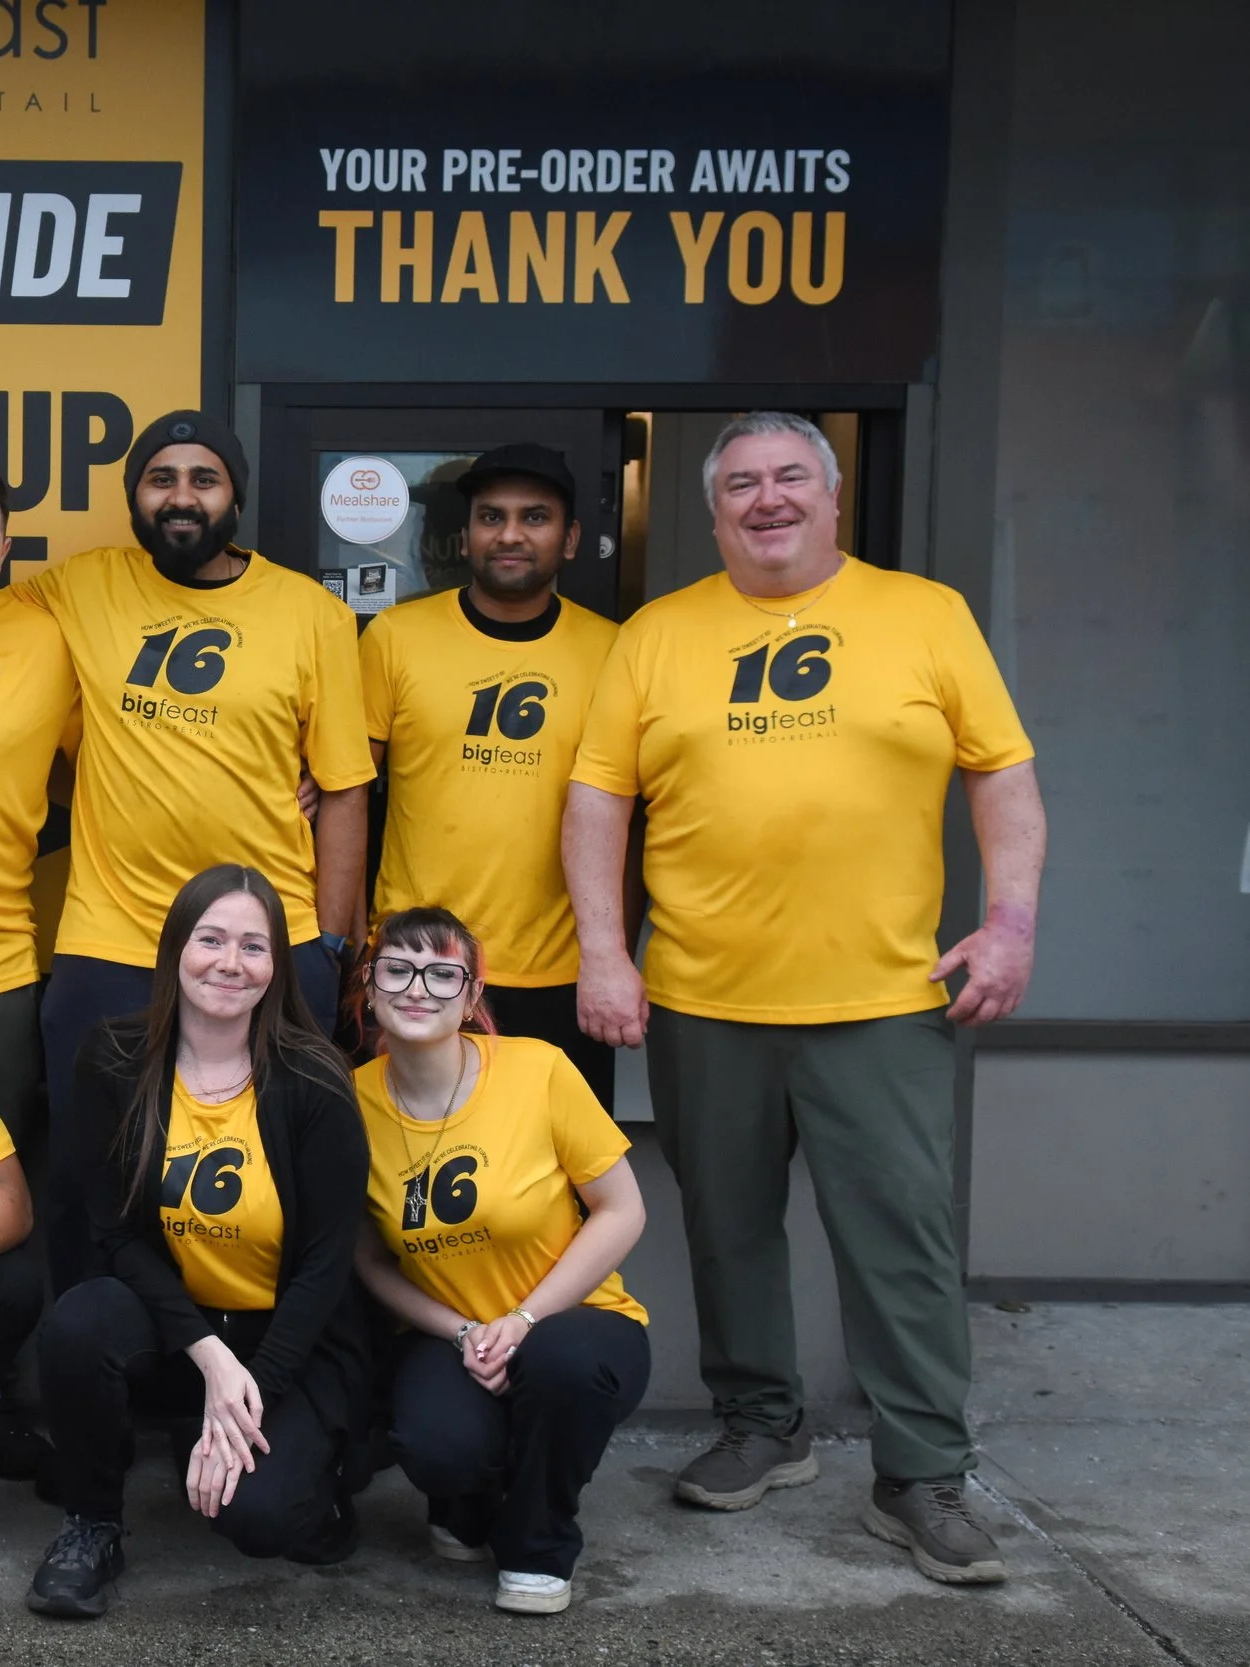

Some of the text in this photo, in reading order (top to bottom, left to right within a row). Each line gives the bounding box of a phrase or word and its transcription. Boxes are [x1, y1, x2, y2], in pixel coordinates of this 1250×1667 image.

[319, 148, 850, 193] YOUR PRE-ORDER AWAITS
[318, 210, 846, 305] THANK YOU
[330, 494, 400, 507] Mealshare
[125, 626, 232, 695] 16
[729, 634, 832, 703] 16
[121, 692, 218, 725] bigfeast
[465, 681, 548, 741] 16
[728, 704, 836, 734] bigfeast
[462, 743, 542, 766] bigfeast
[159, 1147, 245, 1215] 16
[402, 1155, 478, 1231] 16
[403, 1225, 492, 1254] bigfeast
